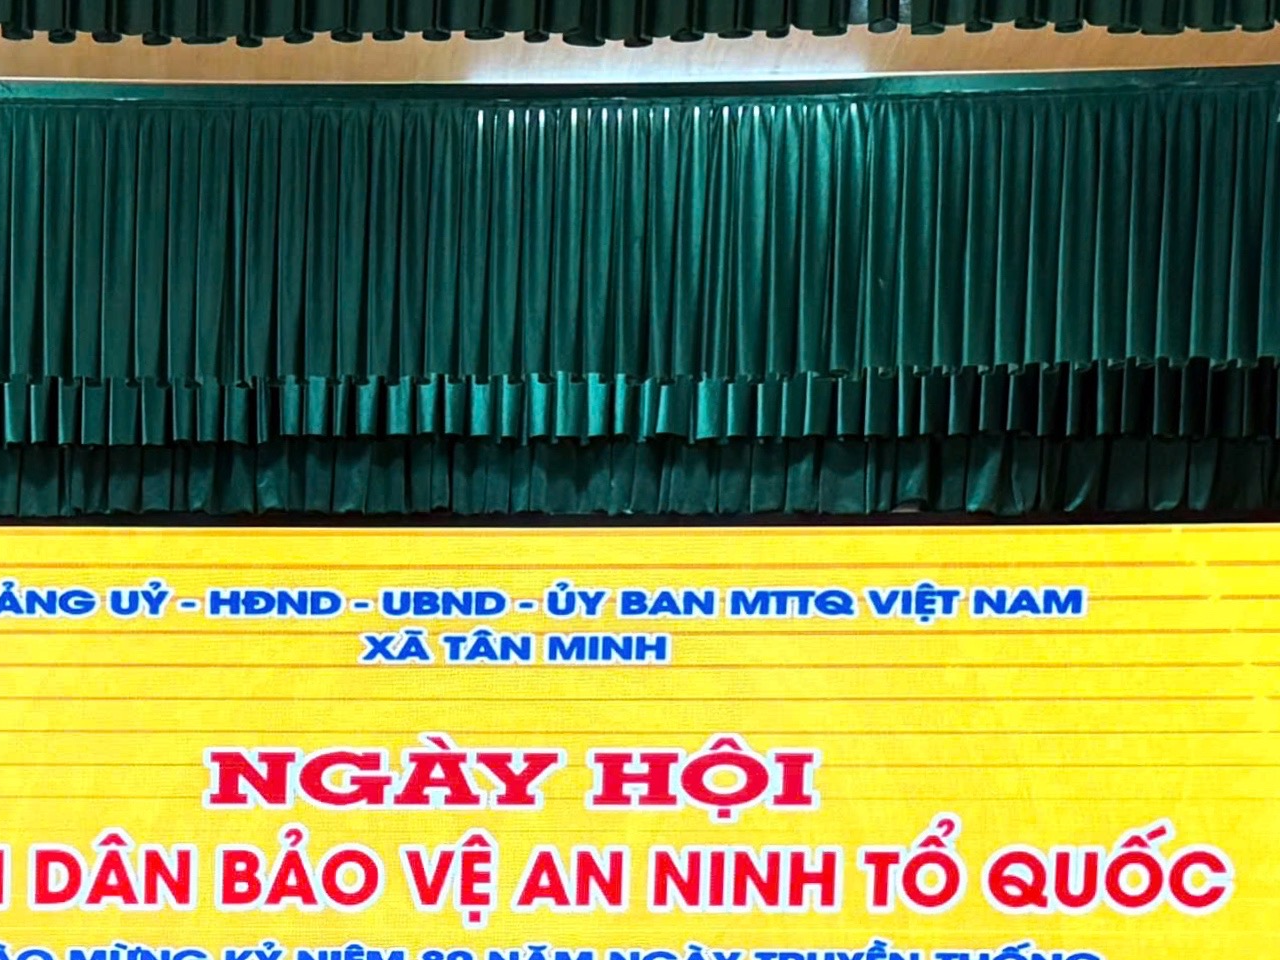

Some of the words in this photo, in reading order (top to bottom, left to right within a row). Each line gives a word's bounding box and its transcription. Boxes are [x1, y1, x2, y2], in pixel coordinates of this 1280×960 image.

[111, 582, 168, 615] UỶ
[210, 591, 341, 615] HĐND
[383, 592, 506, 616] UBND
[548, 582, 605, 616] ỦY
[621, 591, 714, 616] BAN
[730, 590, 854, 616] MTTQ
[869, 582, 960, 622] VIỆT
[974, 590, 1082, 615] NAM
[364, 630, 429, 660] XÃ
[444, 630, 530, 660] TÂN
[549, 636, 666, 660] MINH
[211, 737, 557, 806] NGÀY
[594, 738, 813, 818] HỘI
[35, 834, 190, 905] DÂN
[223, 829, 378, 905] BẢO
[408, 835, 490, 922] VỆ
[519, 852, 622, 906] AN
[654, 852, 835, 906] NINH
[865, 820, 959, 907] TỔ
[989, 827, 1227, 908] QUỐC
